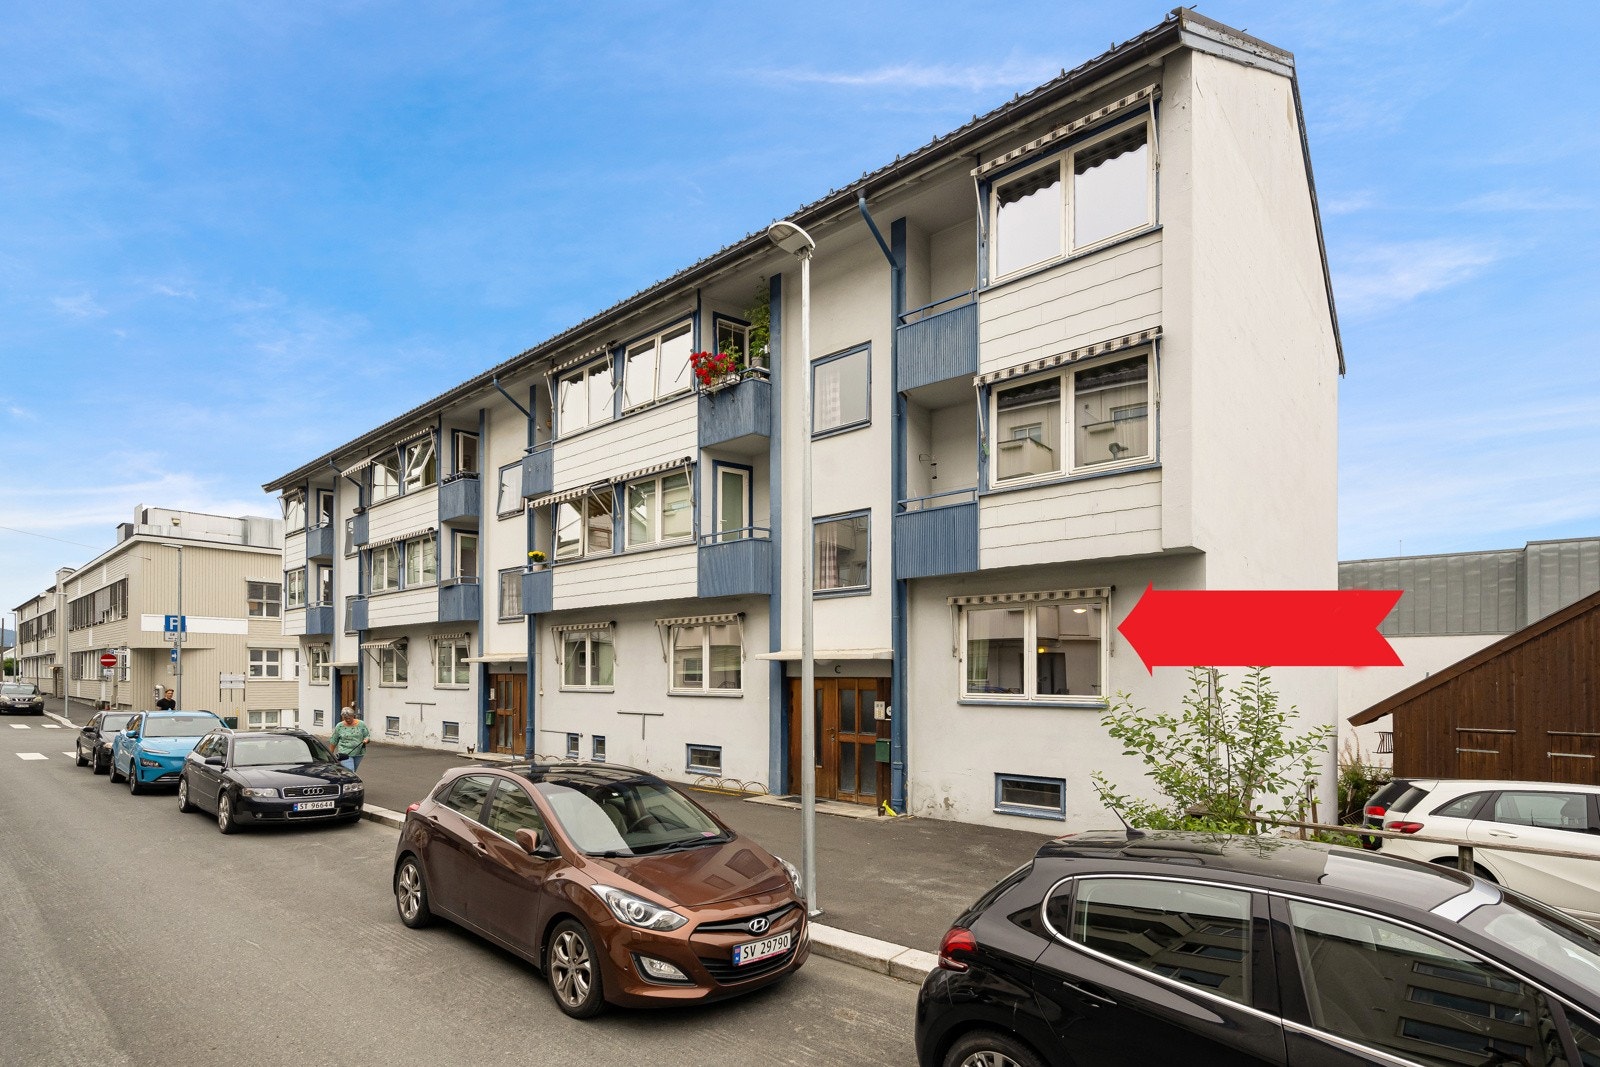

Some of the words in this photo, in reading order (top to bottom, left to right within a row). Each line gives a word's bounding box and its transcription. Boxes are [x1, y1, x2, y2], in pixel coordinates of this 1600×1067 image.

[834, 665, 841, 674] C
[311, 801, 333, 809] 96644
[743, 944, 757, 960] SV
[760, 935, 789, 955] 29790
